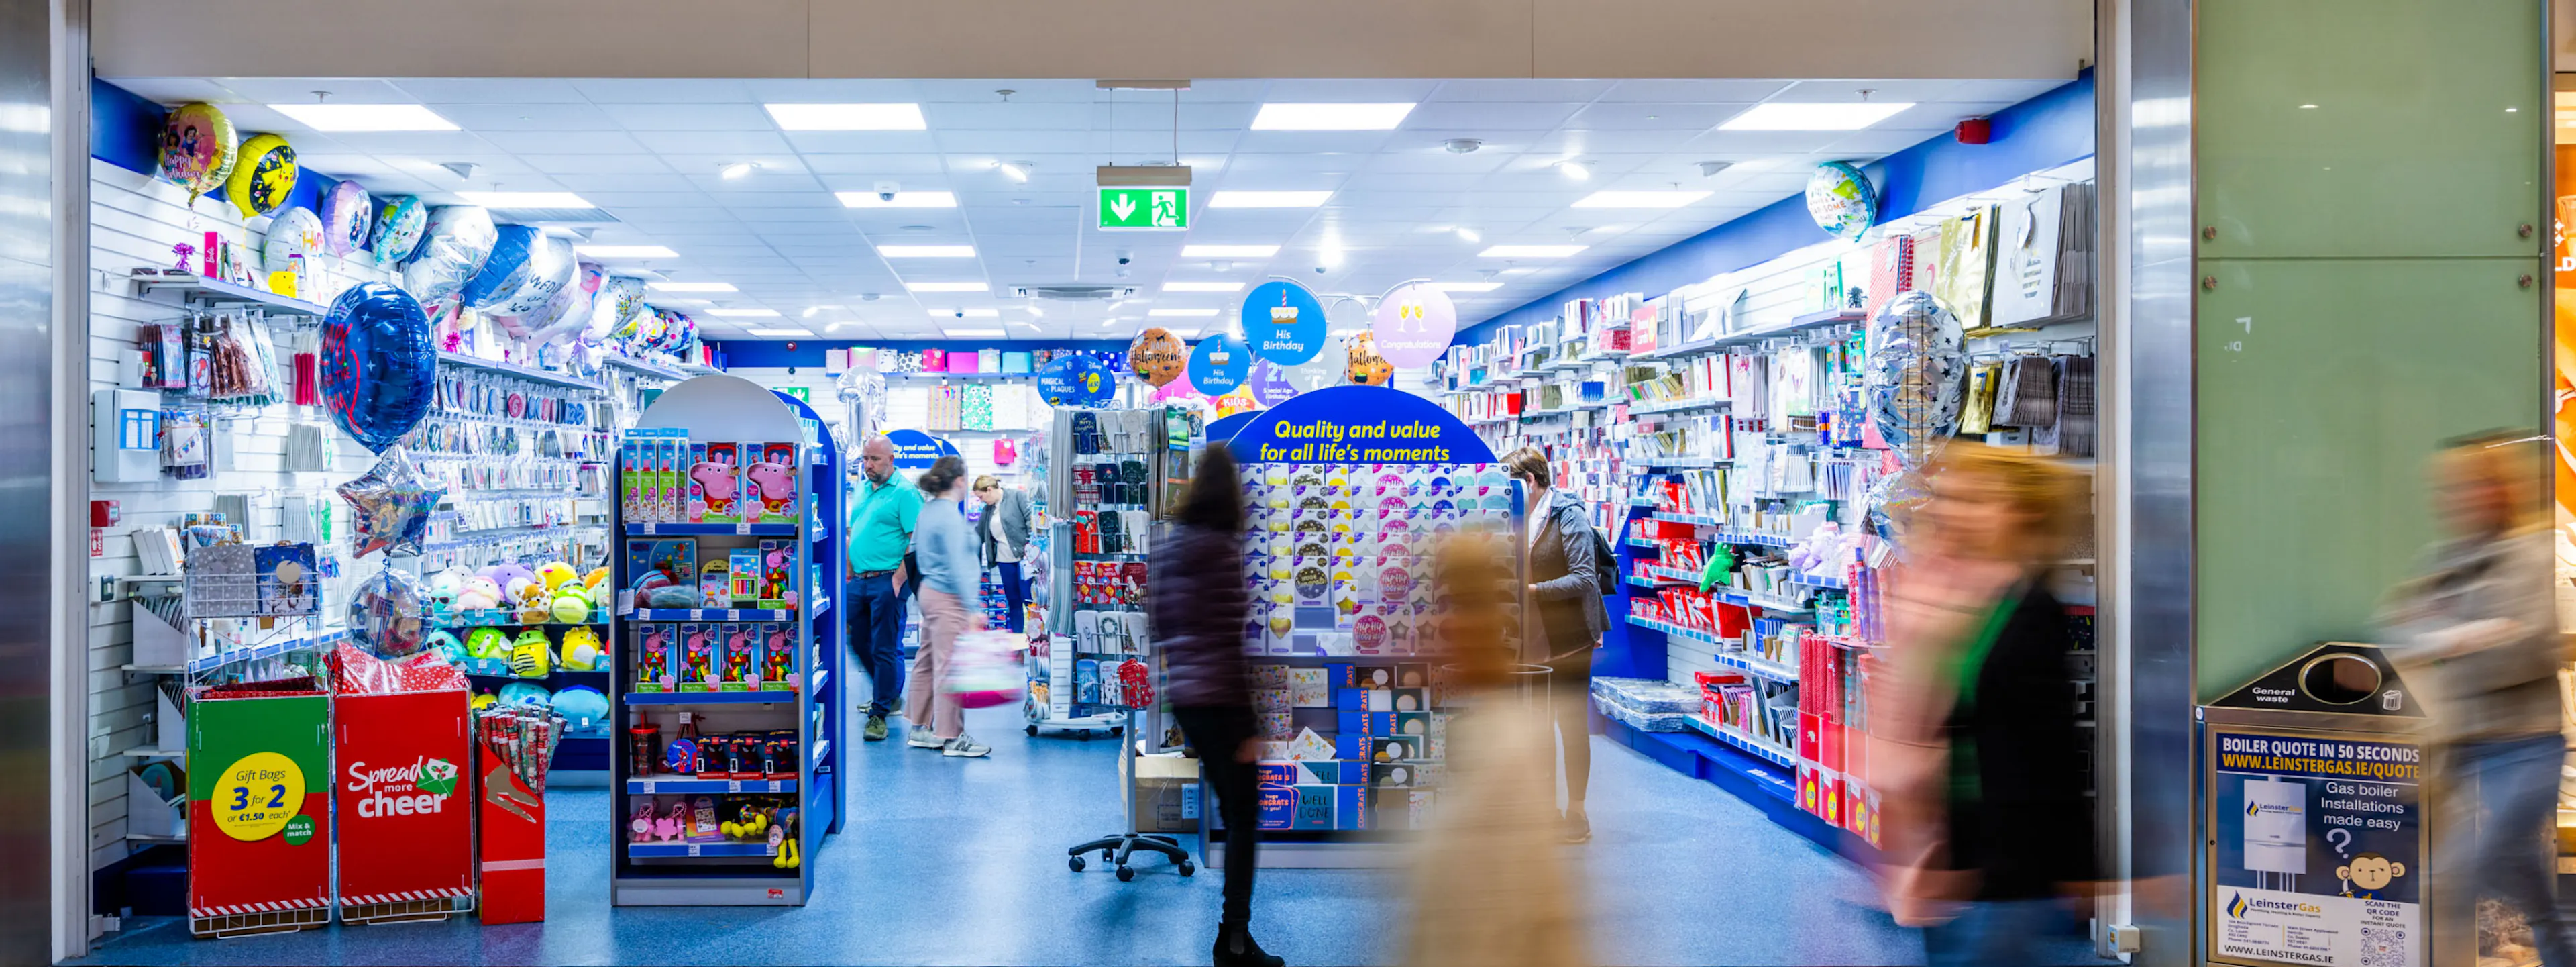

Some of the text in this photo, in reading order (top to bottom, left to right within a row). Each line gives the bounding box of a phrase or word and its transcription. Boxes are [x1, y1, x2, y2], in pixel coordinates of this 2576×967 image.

[164, 152, 191, 169] Happy
[1276, 329, 1291, 339] His
[1263, 340, 1303, 352] Birthday
[1381, 340, 1441, 351] Congratulations
[1203, 377, 1234, 386] Birthday
[1223, 397, 1247, 407] KIDS
[1275, 420, 1441, 442] Quality and value
[1260, 443, 1450, 461] for all life's moments
[2252, 686, 2295, 696] General
[2222, 737, 2420, 762] BOILER QUOTE IN 50 SECONDS
[2222, 753, 2420, 779] WWW.LEINSTERGAS.IE/QUOTE
[236, 769, 286, 784] Gift Bags
[347, 755, 425, 794] Spread
[1315, 771, 1330, 781] ELL
[384, 784, 413, 793] more
[2326, 781, 2398, 797] Gas boiler
[230, 784, 286, 811] 3 for 2
[358, 791, 447, 818] cheer
[1302, 795, 1327, 805] WELL
[1299, 807, 1329, 818] DONE
[2321, 797, 2404, 814] Installations
[239, 813, 264, 821] €1.50
[2324, 815, 2401, 832] made easy
[2249, 898, 2320, 913] LeinsterGas
[2224, 945, 2334, 964] WWW.LEINSTERGAS.IE
